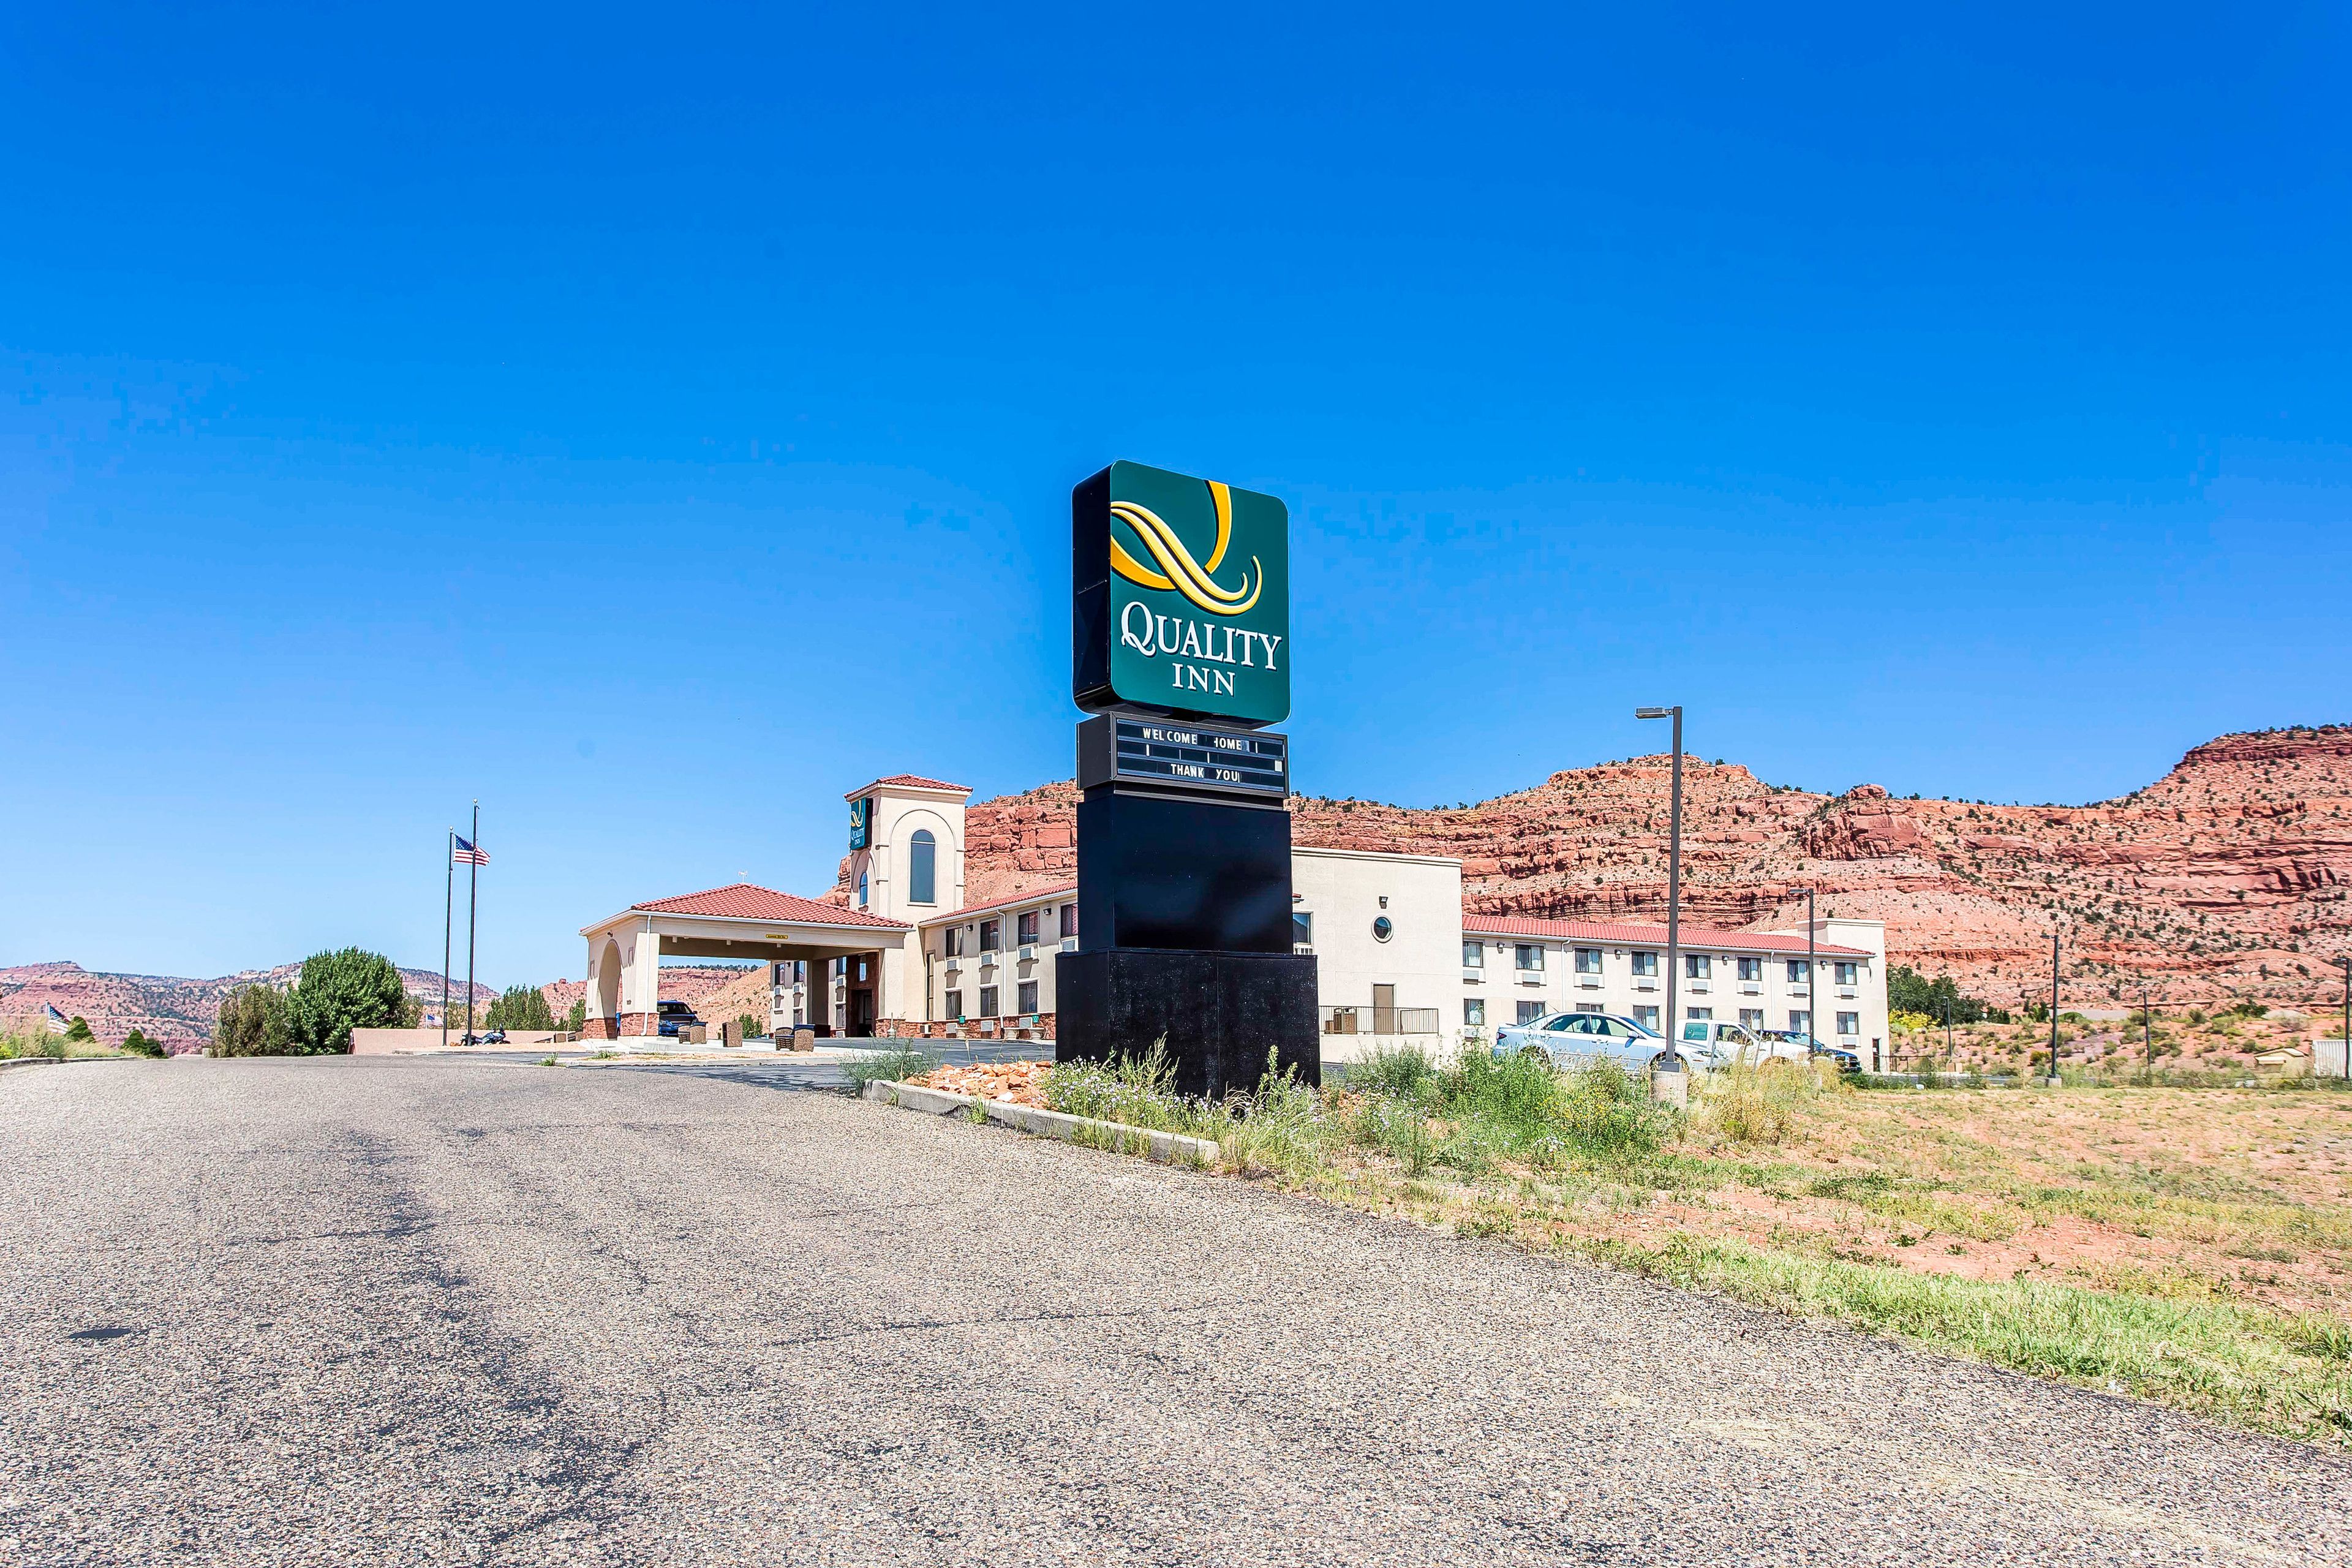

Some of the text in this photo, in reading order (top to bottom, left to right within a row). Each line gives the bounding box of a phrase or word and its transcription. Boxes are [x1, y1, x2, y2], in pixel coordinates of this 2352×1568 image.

[1121, 601, 1283, 670] QUALITY
[1172, 662, 1235, 696] INN
[1142, 727, 1198, 745] WELCOME
[1170, 763, 1238, 782] THANK YOU
